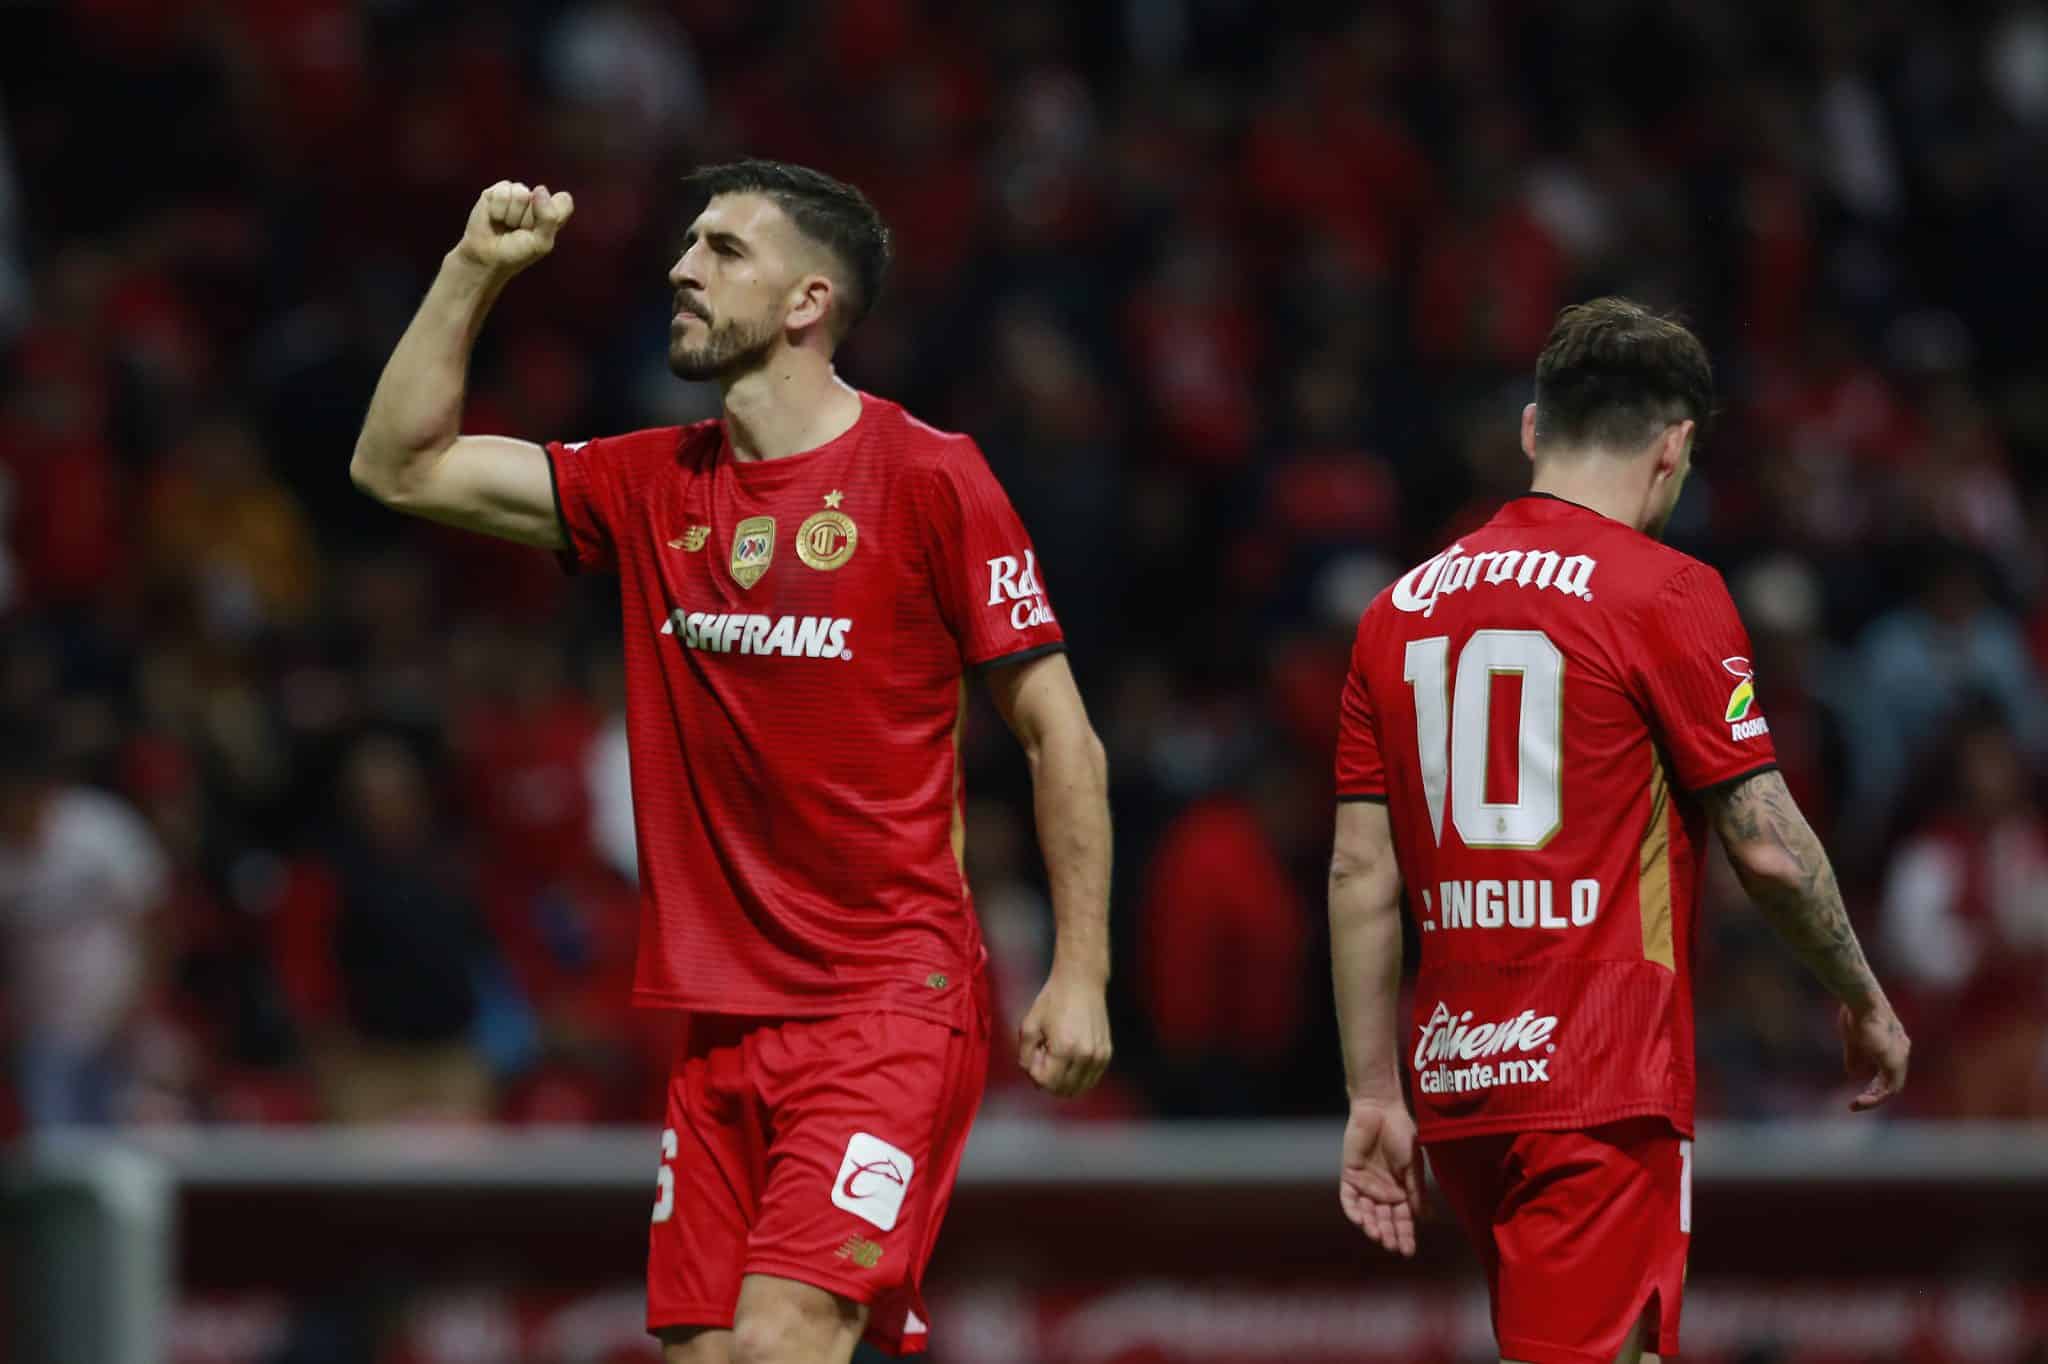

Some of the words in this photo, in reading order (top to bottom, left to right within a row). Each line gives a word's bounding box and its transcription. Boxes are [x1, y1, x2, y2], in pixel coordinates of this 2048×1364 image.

[1391, 544, 1596, 618] Corona
[660, 608, 852, 660] SHFRANS
[1403, 629, 1565, 850] 10
[1414, 1000, 1558, 1071] Caliente
[1420, 1059, 1550, 1093] caliente.mx
